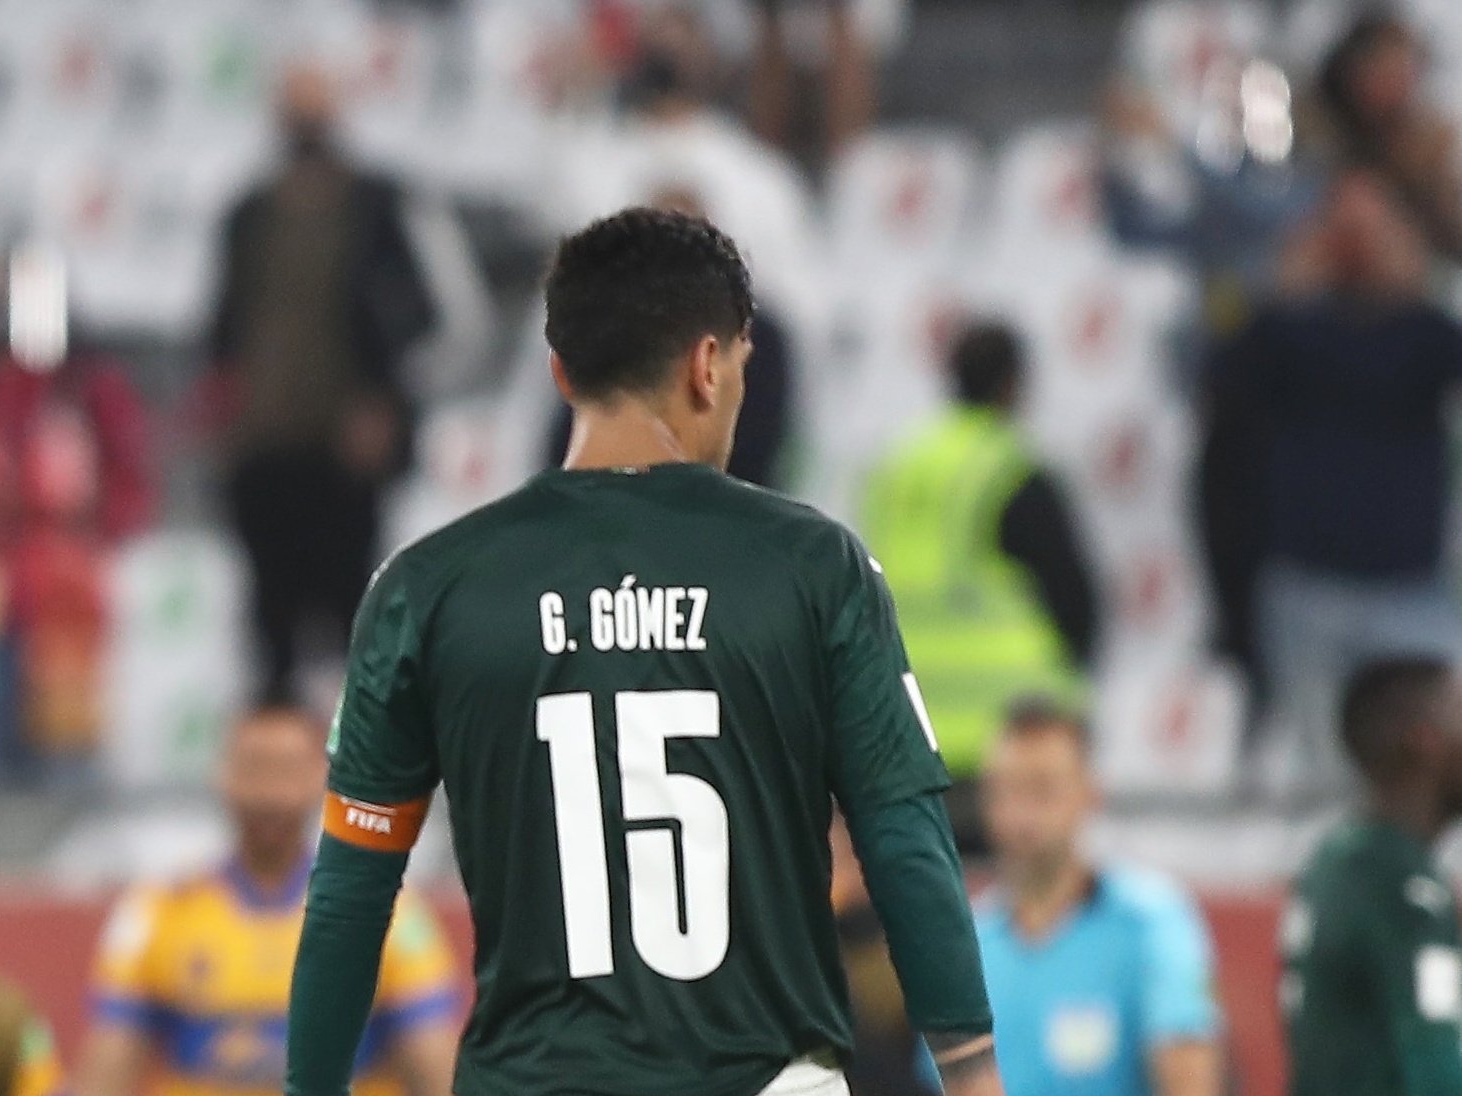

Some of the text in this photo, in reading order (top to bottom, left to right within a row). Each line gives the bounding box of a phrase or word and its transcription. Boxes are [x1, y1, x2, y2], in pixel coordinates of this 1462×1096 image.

[539, 573, 709, 655] G. GÓMEZ
[345, 806, 392, 834] FIFA
[536, 690, 730, 982] 15
